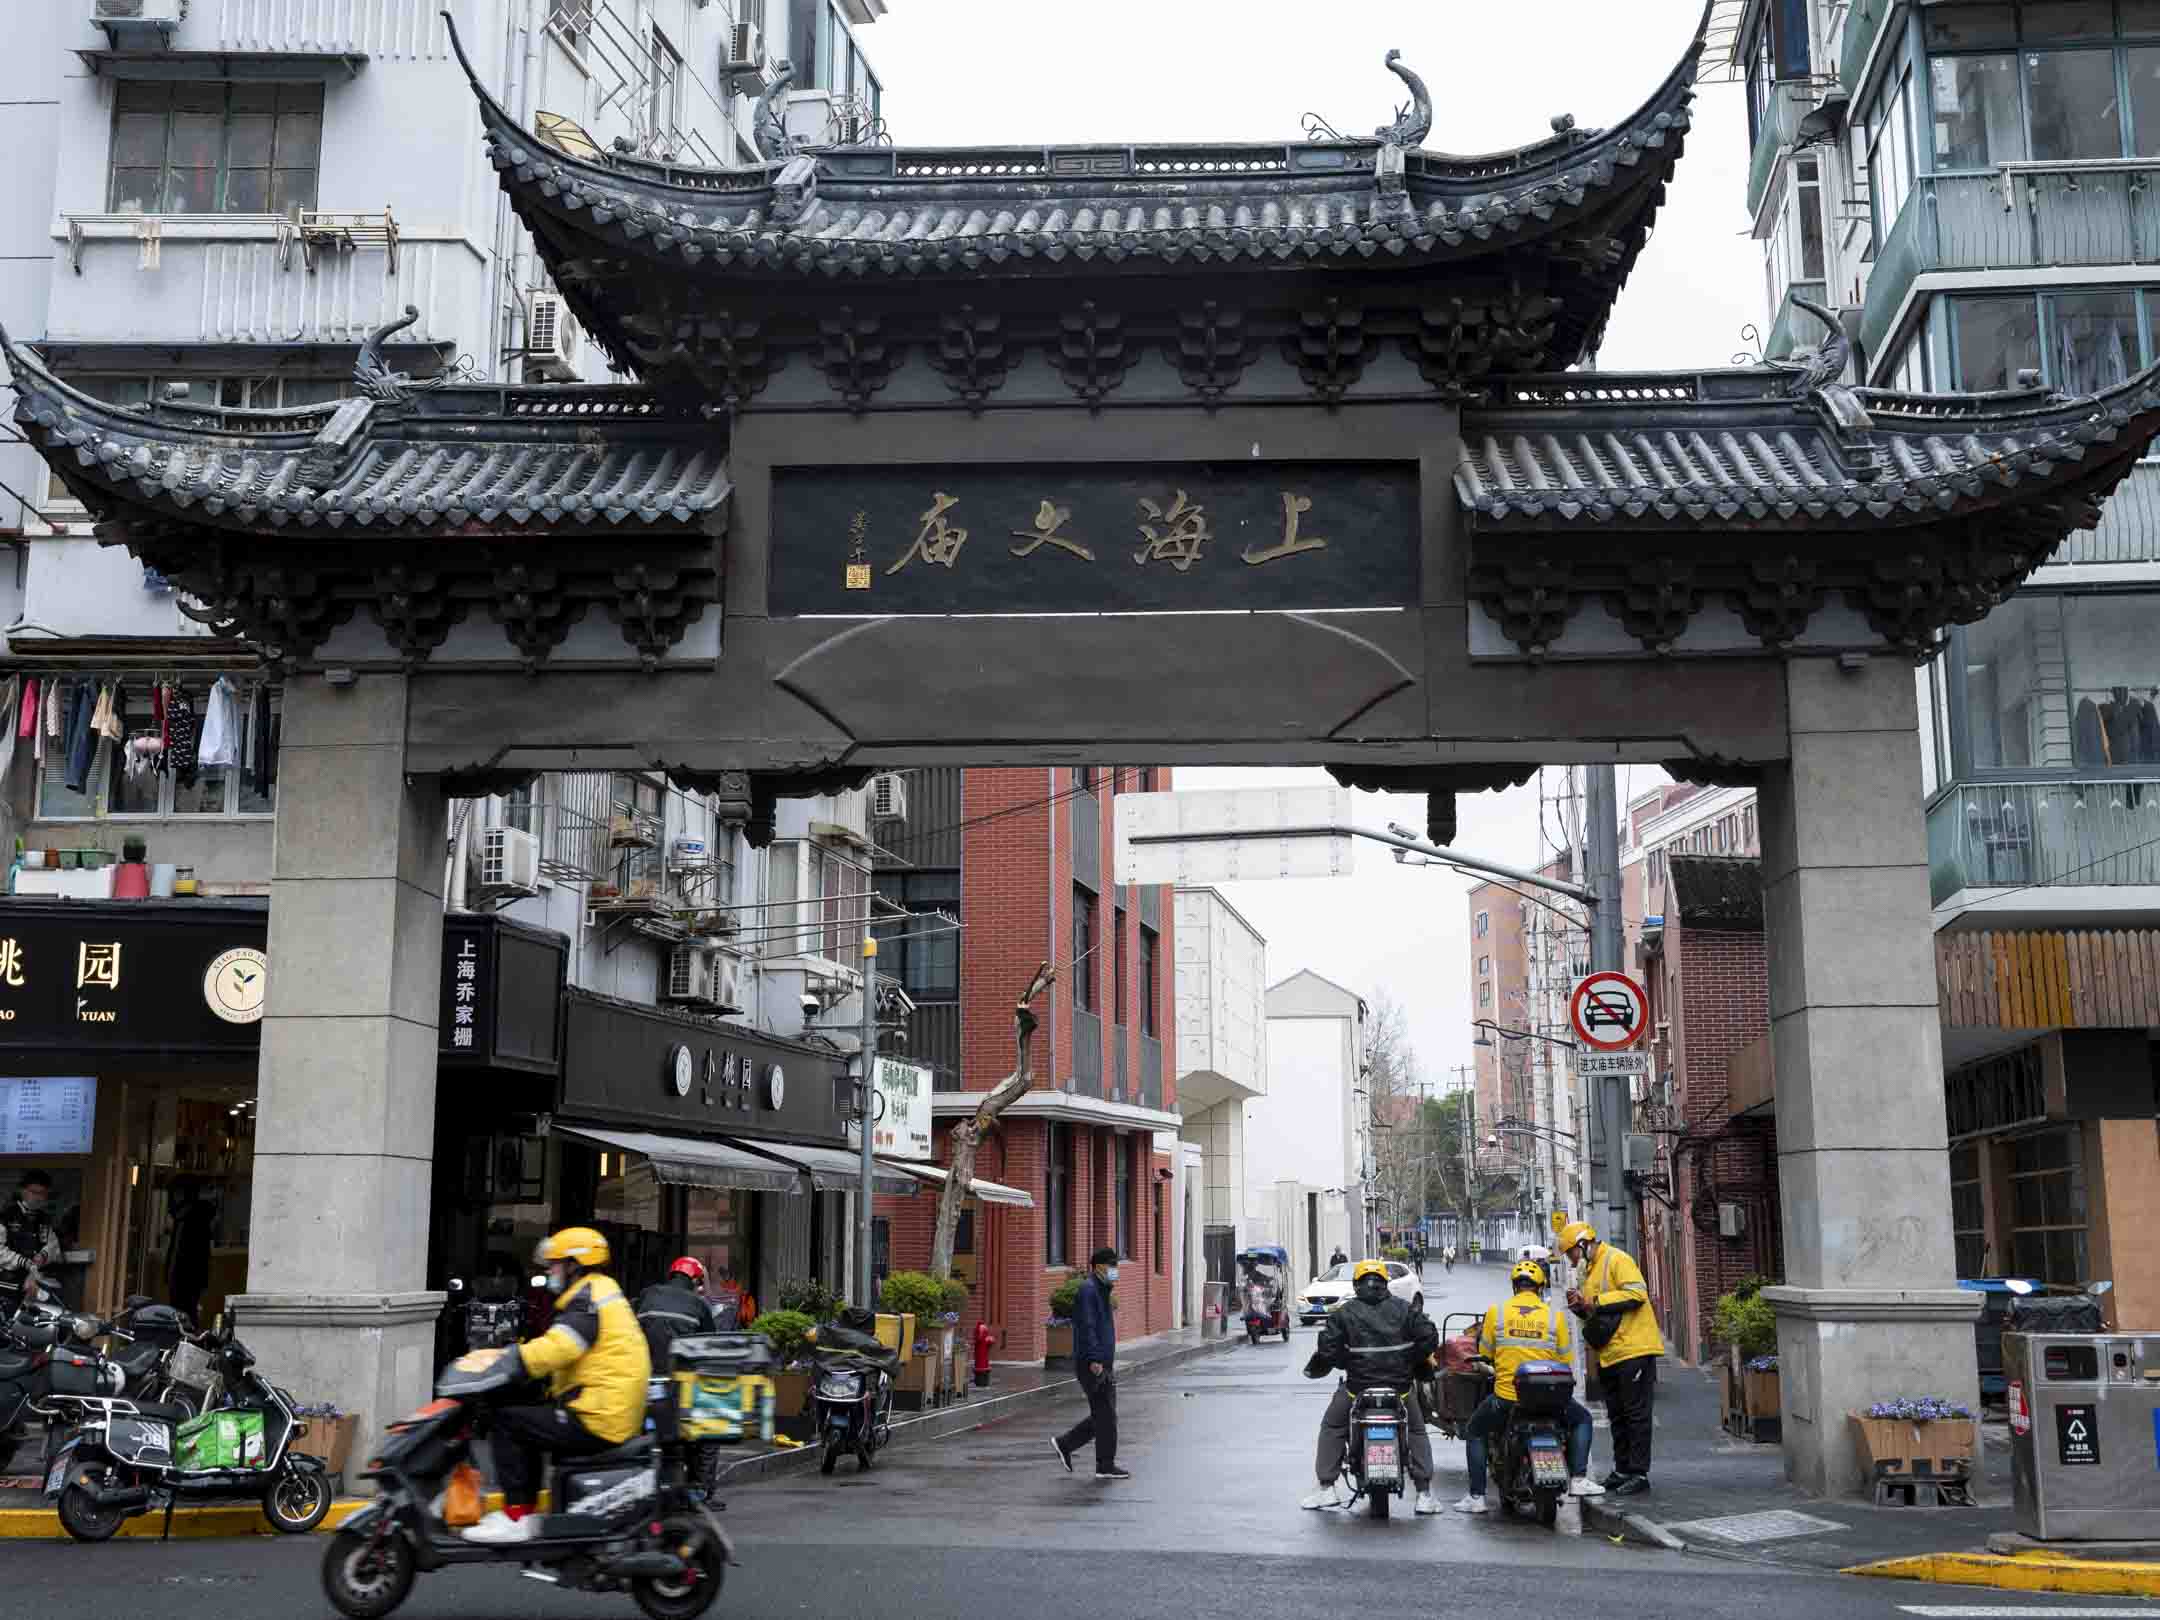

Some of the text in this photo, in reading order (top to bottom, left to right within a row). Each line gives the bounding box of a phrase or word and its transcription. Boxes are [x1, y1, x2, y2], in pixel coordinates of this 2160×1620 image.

[453, 939, 477, 1046] 上海乔家栅
[81, 1011, 116, 1022] YUAN
[704, 1048, 752, 1089] 小桃园
